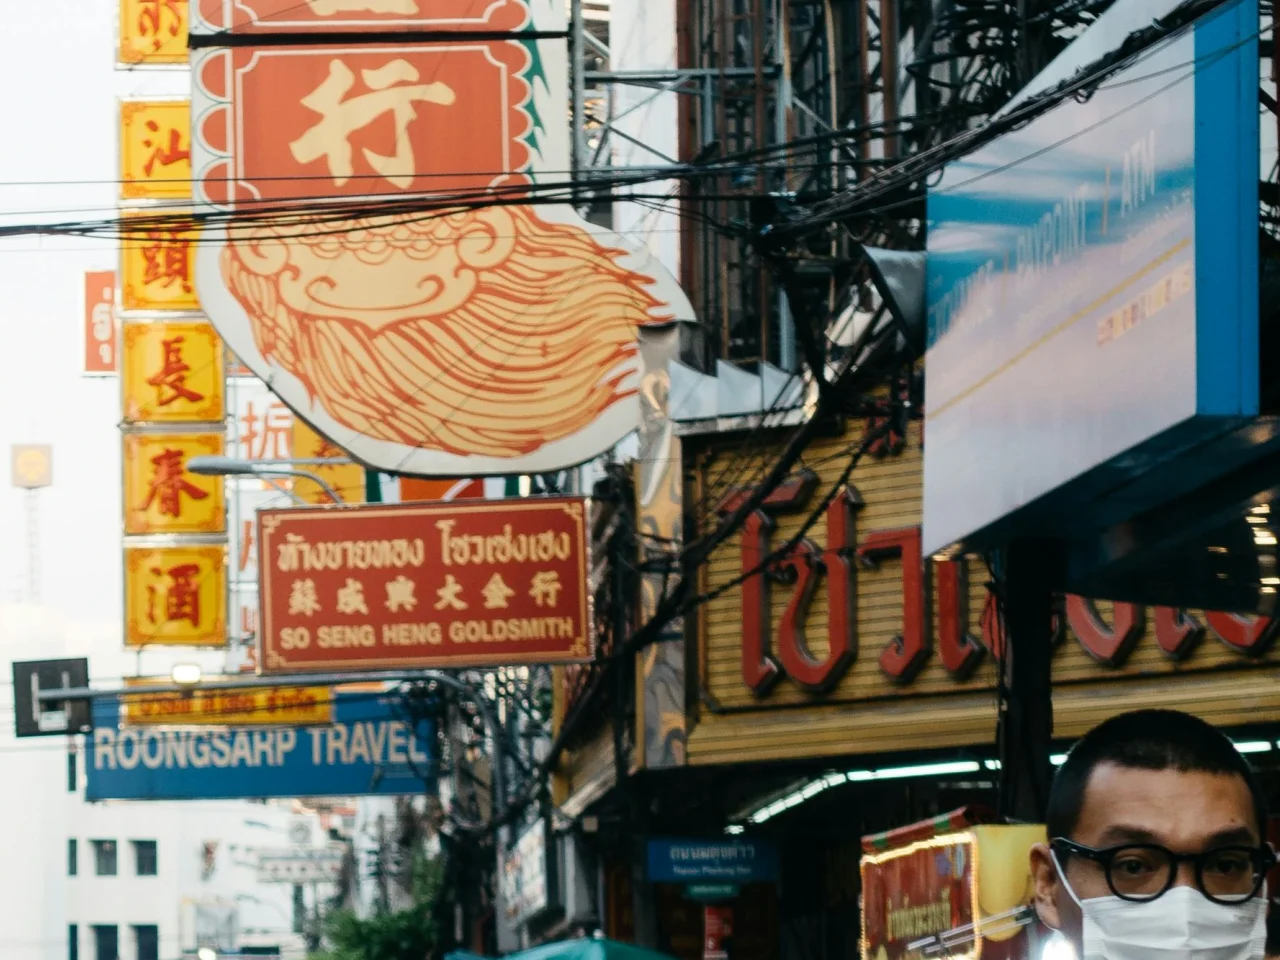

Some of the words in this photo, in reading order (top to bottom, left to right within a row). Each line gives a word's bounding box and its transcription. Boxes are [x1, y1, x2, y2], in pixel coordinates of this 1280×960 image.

[287, 59, 457, 188] 行
[280, 627, 310, 651] SO
[317, 624, 376, 649] SENG
[382, 621, 443, 646] HENG
[448, 616, 574, 643] GOLDSMITH
[93, 725, 297, 770] ROONGSARP
[306, 720, 428, 767] TRAVEL
